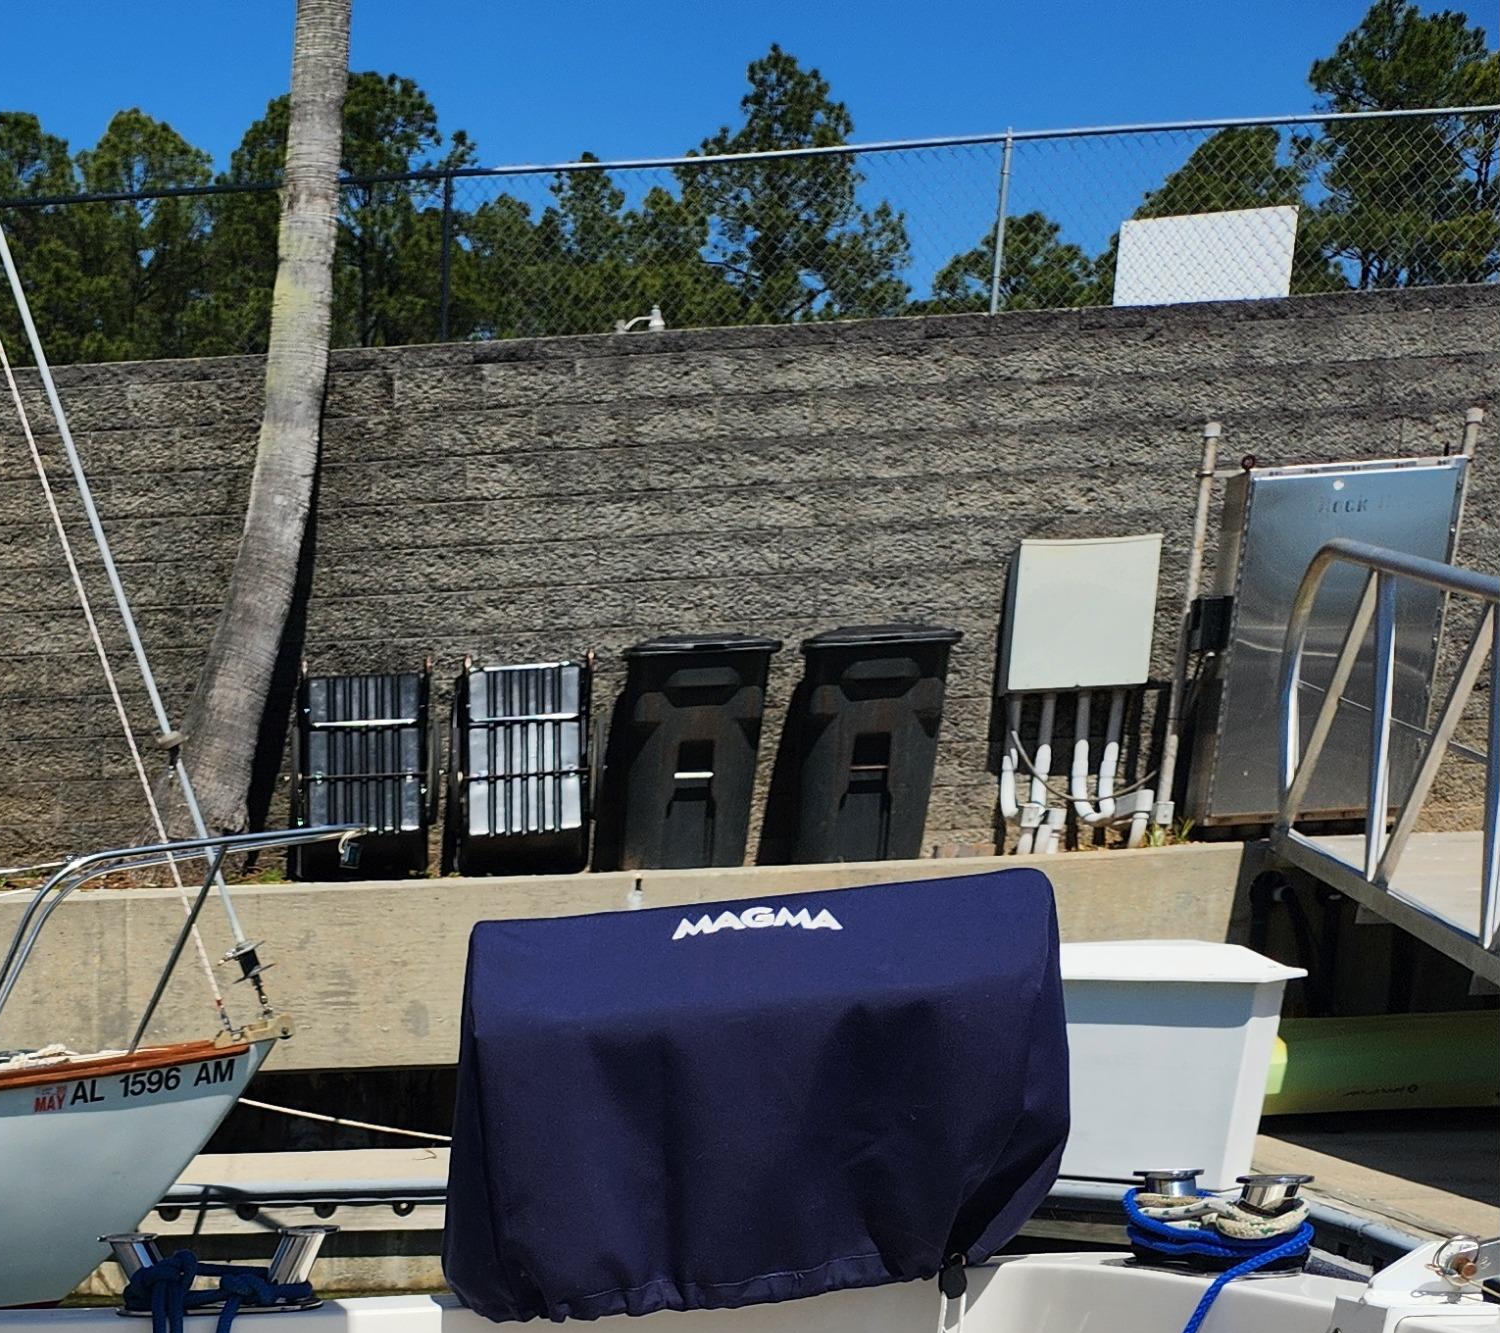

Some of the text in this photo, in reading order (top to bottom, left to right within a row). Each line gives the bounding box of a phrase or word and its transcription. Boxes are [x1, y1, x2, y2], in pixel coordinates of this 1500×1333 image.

[671, 906, 844, 941] MAGMA
[70, 1058, 236, 1106] AL 1596 AM
[34, 1094, 66, 1113] MAY
